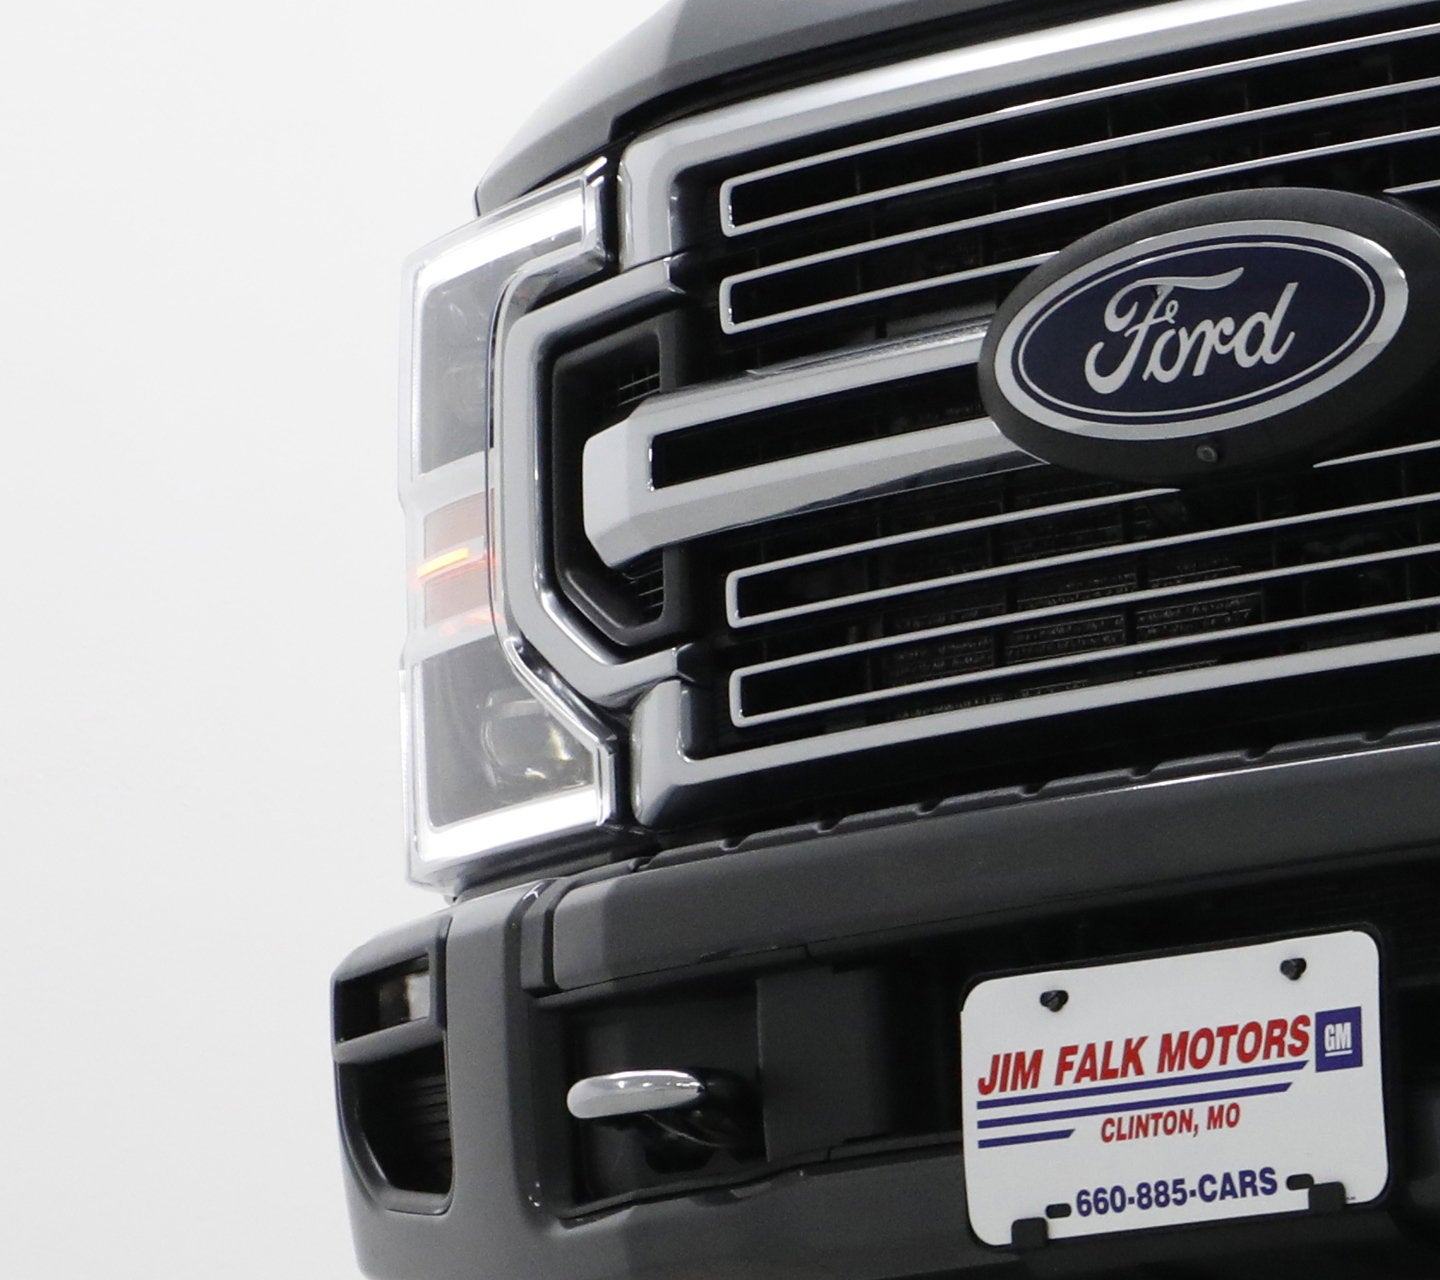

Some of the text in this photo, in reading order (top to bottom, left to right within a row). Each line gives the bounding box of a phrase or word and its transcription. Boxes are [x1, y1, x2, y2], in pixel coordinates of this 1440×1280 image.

[1084, 266, 1299, 394] Ford
[978, 1014, 1311, 1095] JIM FALK MOTORS
[1323, 1021, 1353, 1052] GM
[1100, 1102, 1241, 1144] CLINTON, MO
[1075, 1166, 1278, 1217] 660-885-CARS
